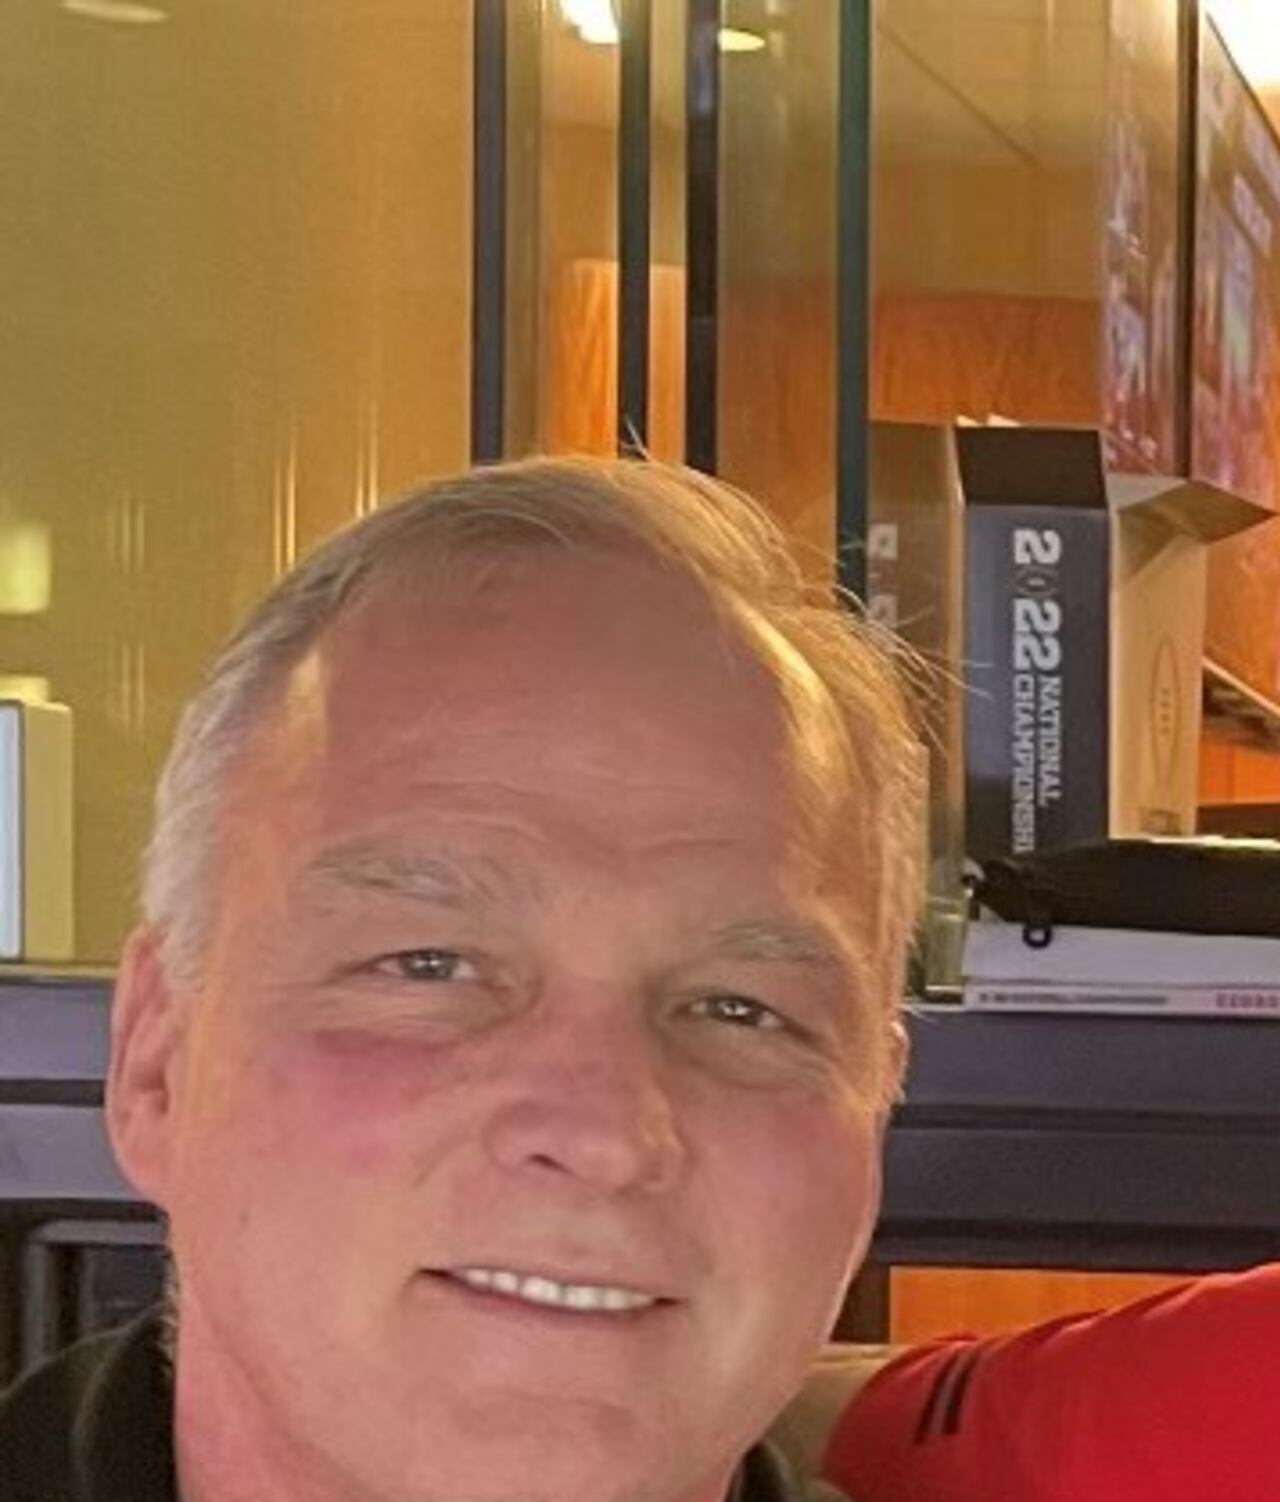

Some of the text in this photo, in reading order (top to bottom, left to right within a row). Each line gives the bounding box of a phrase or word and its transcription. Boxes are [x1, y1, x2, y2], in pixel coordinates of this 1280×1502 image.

[1013, 528, 1062, 670] 2022
[1012, 673, 1035, 853] CHAMPIONSHI
[1039, 675, 1063, 808] NATIONAL
